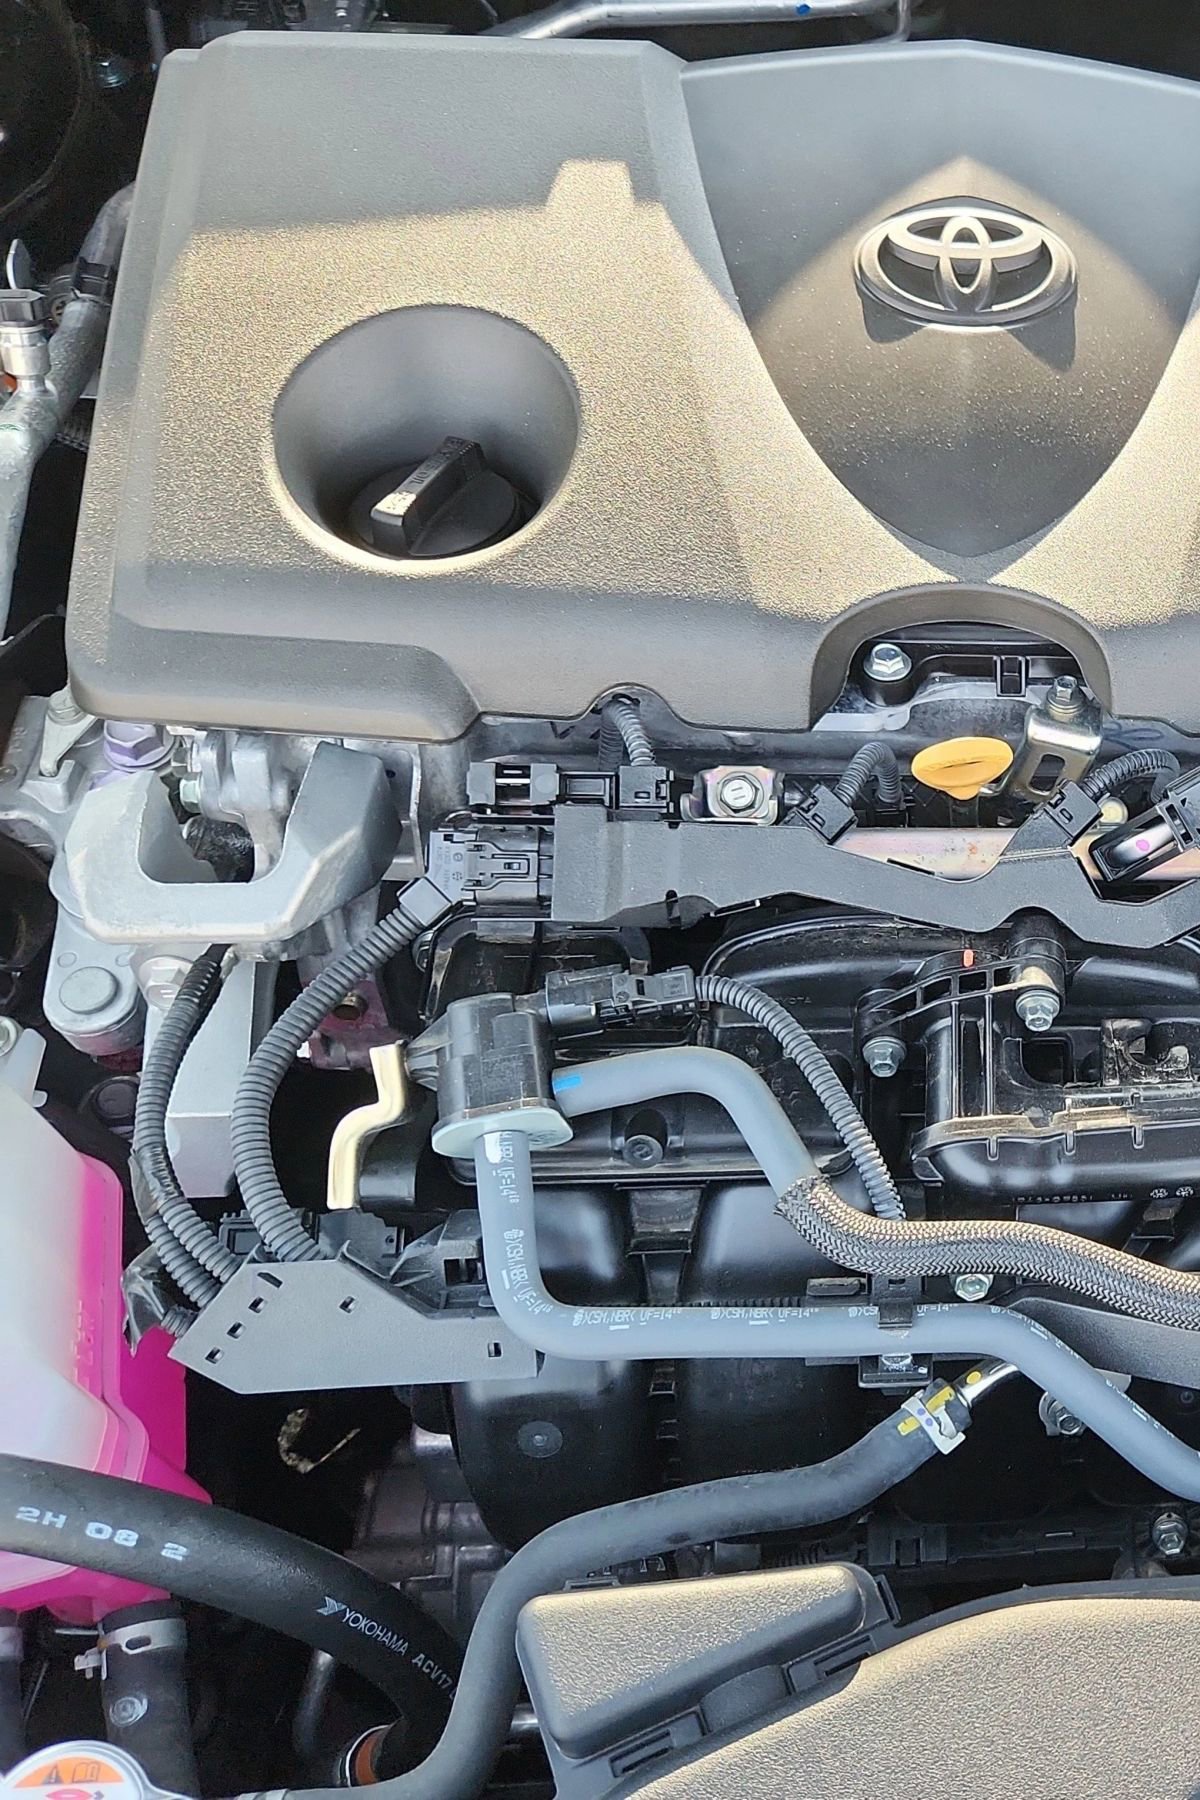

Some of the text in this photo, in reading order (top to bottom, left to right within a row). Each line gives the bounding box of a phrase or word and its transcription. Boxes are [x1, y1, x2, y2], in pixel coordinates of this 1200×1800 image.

[15, 1506, 189, 1561] 2H 08 2
[342, 1608, 453, 1689] YOKOHAMA ACV17
